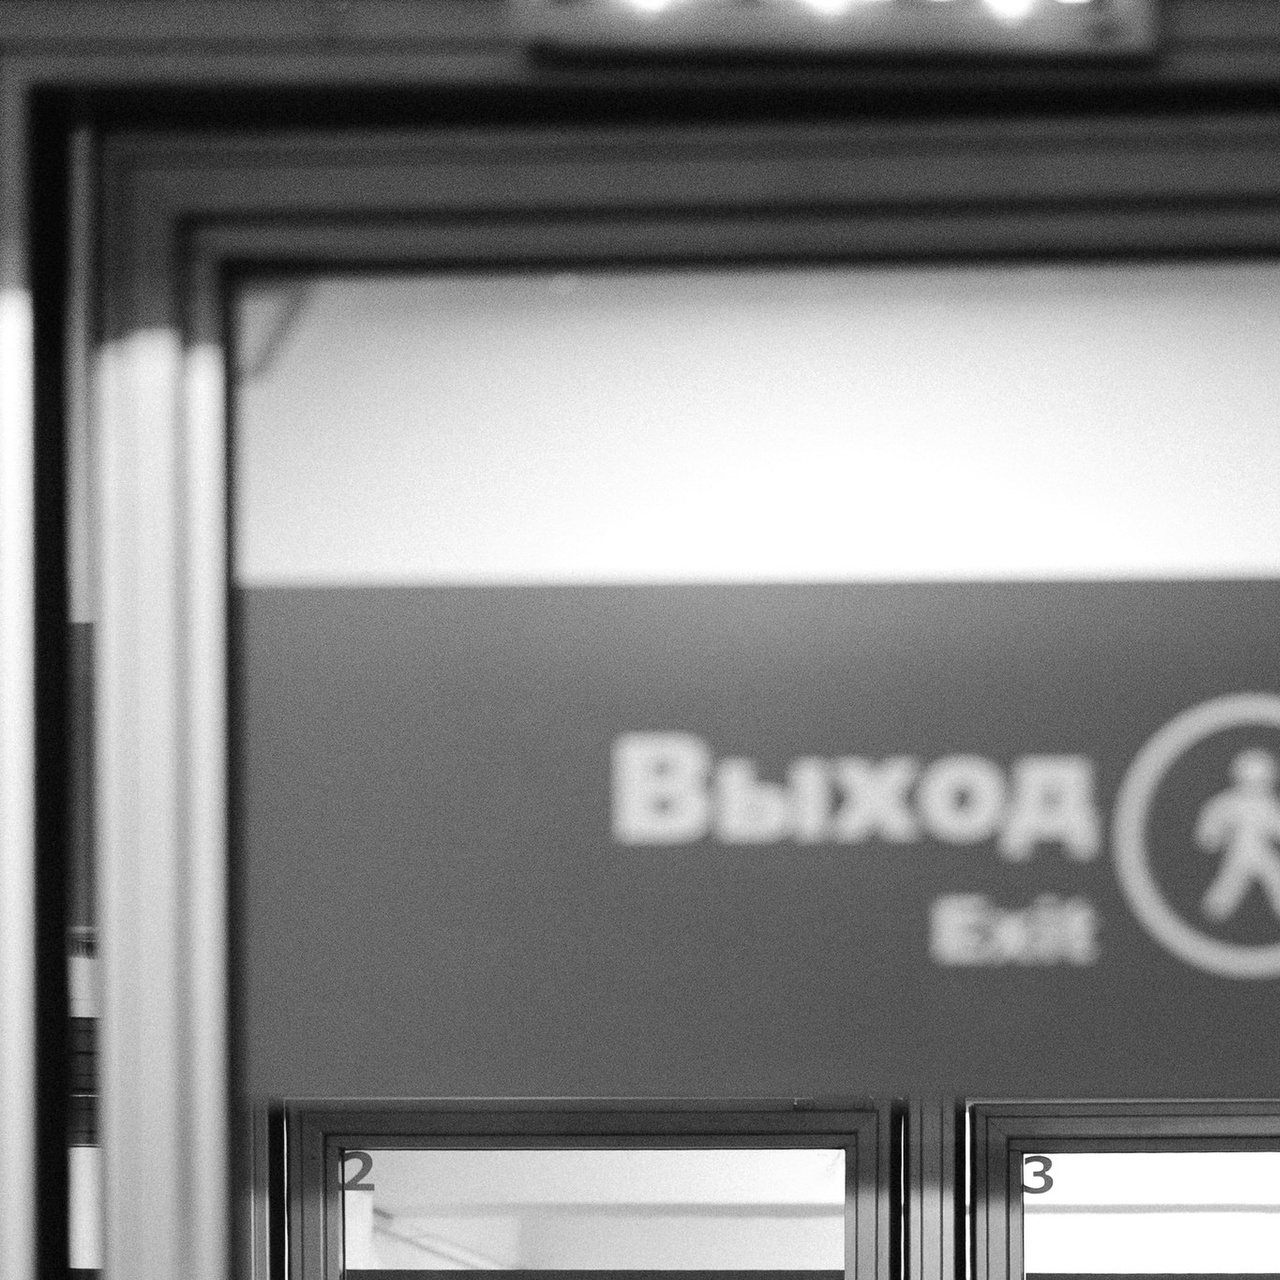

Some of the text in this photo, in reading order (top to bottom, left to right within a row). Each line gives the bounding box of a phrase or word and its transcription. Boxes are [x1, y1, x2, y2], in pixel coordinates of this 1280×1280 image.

[610, 730, 1100, 862] Выход
[928, 892, 1098, 967] Exit
[339, 1151, 375, 1191] 2
[1021, 1155, 1054, 1194] 3
